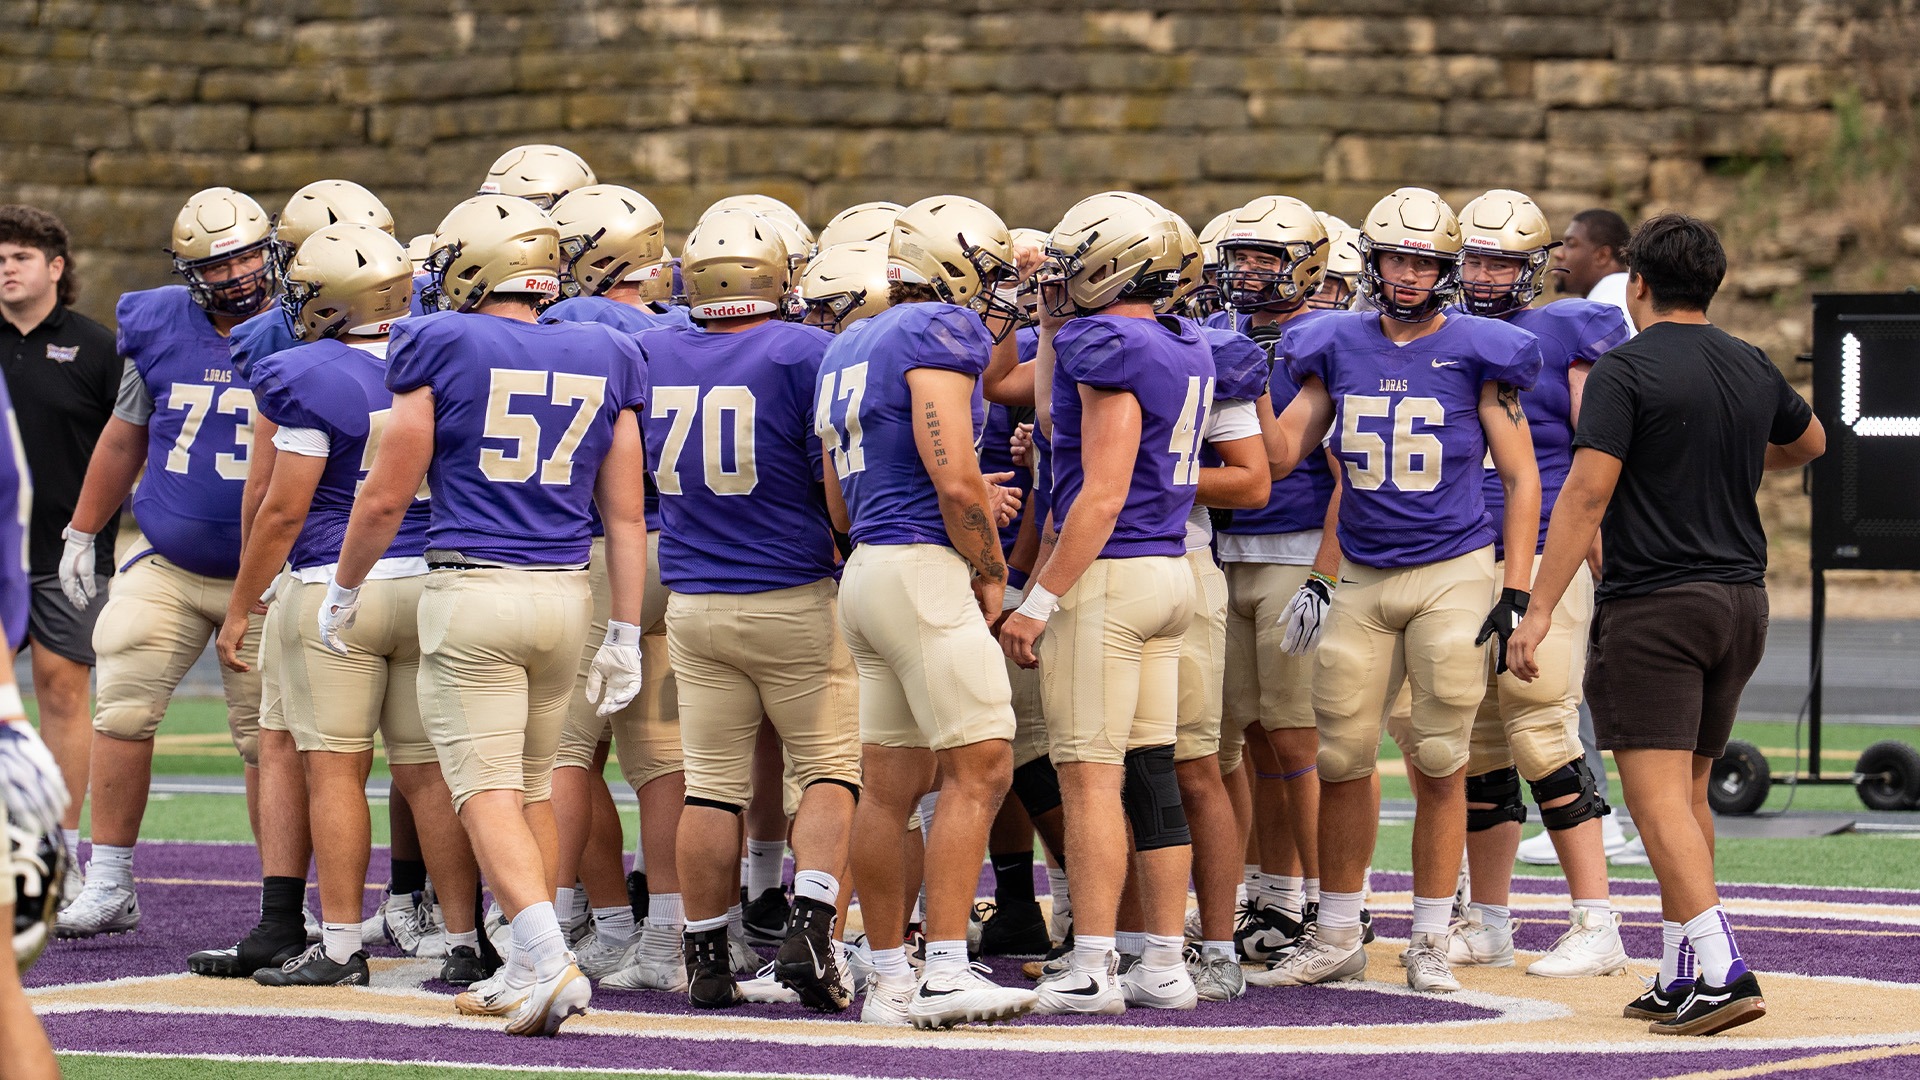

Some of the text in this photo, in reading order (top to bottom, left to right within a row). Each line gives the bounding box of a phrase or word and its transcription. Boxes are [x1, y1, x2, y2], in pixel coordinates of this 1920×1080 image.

[1403, 240, 1431, 250] Riddell
[703, 303, 756, 317] Riddell
[203, 369, 232, 383] LORAS
[1379, 379, 1408, 392] LORAS
[925, 402, 934, 410] JH
[815, 360, 869, 480] 47
[925, 411, 938, 420] BH
[478, 368, 608, 486] 57
[926, 420, 941, 429] MH
[1168, 375, 1214, 486] 41
[164, 382, 260, 481] 73
[930, 429, 941, 438] JW
[650, 385, 759, 496] 70
[1341, 394, 1445, 492] 56
[934, 448, 946, 457] EH
[936, 458, 948, 467] LH
